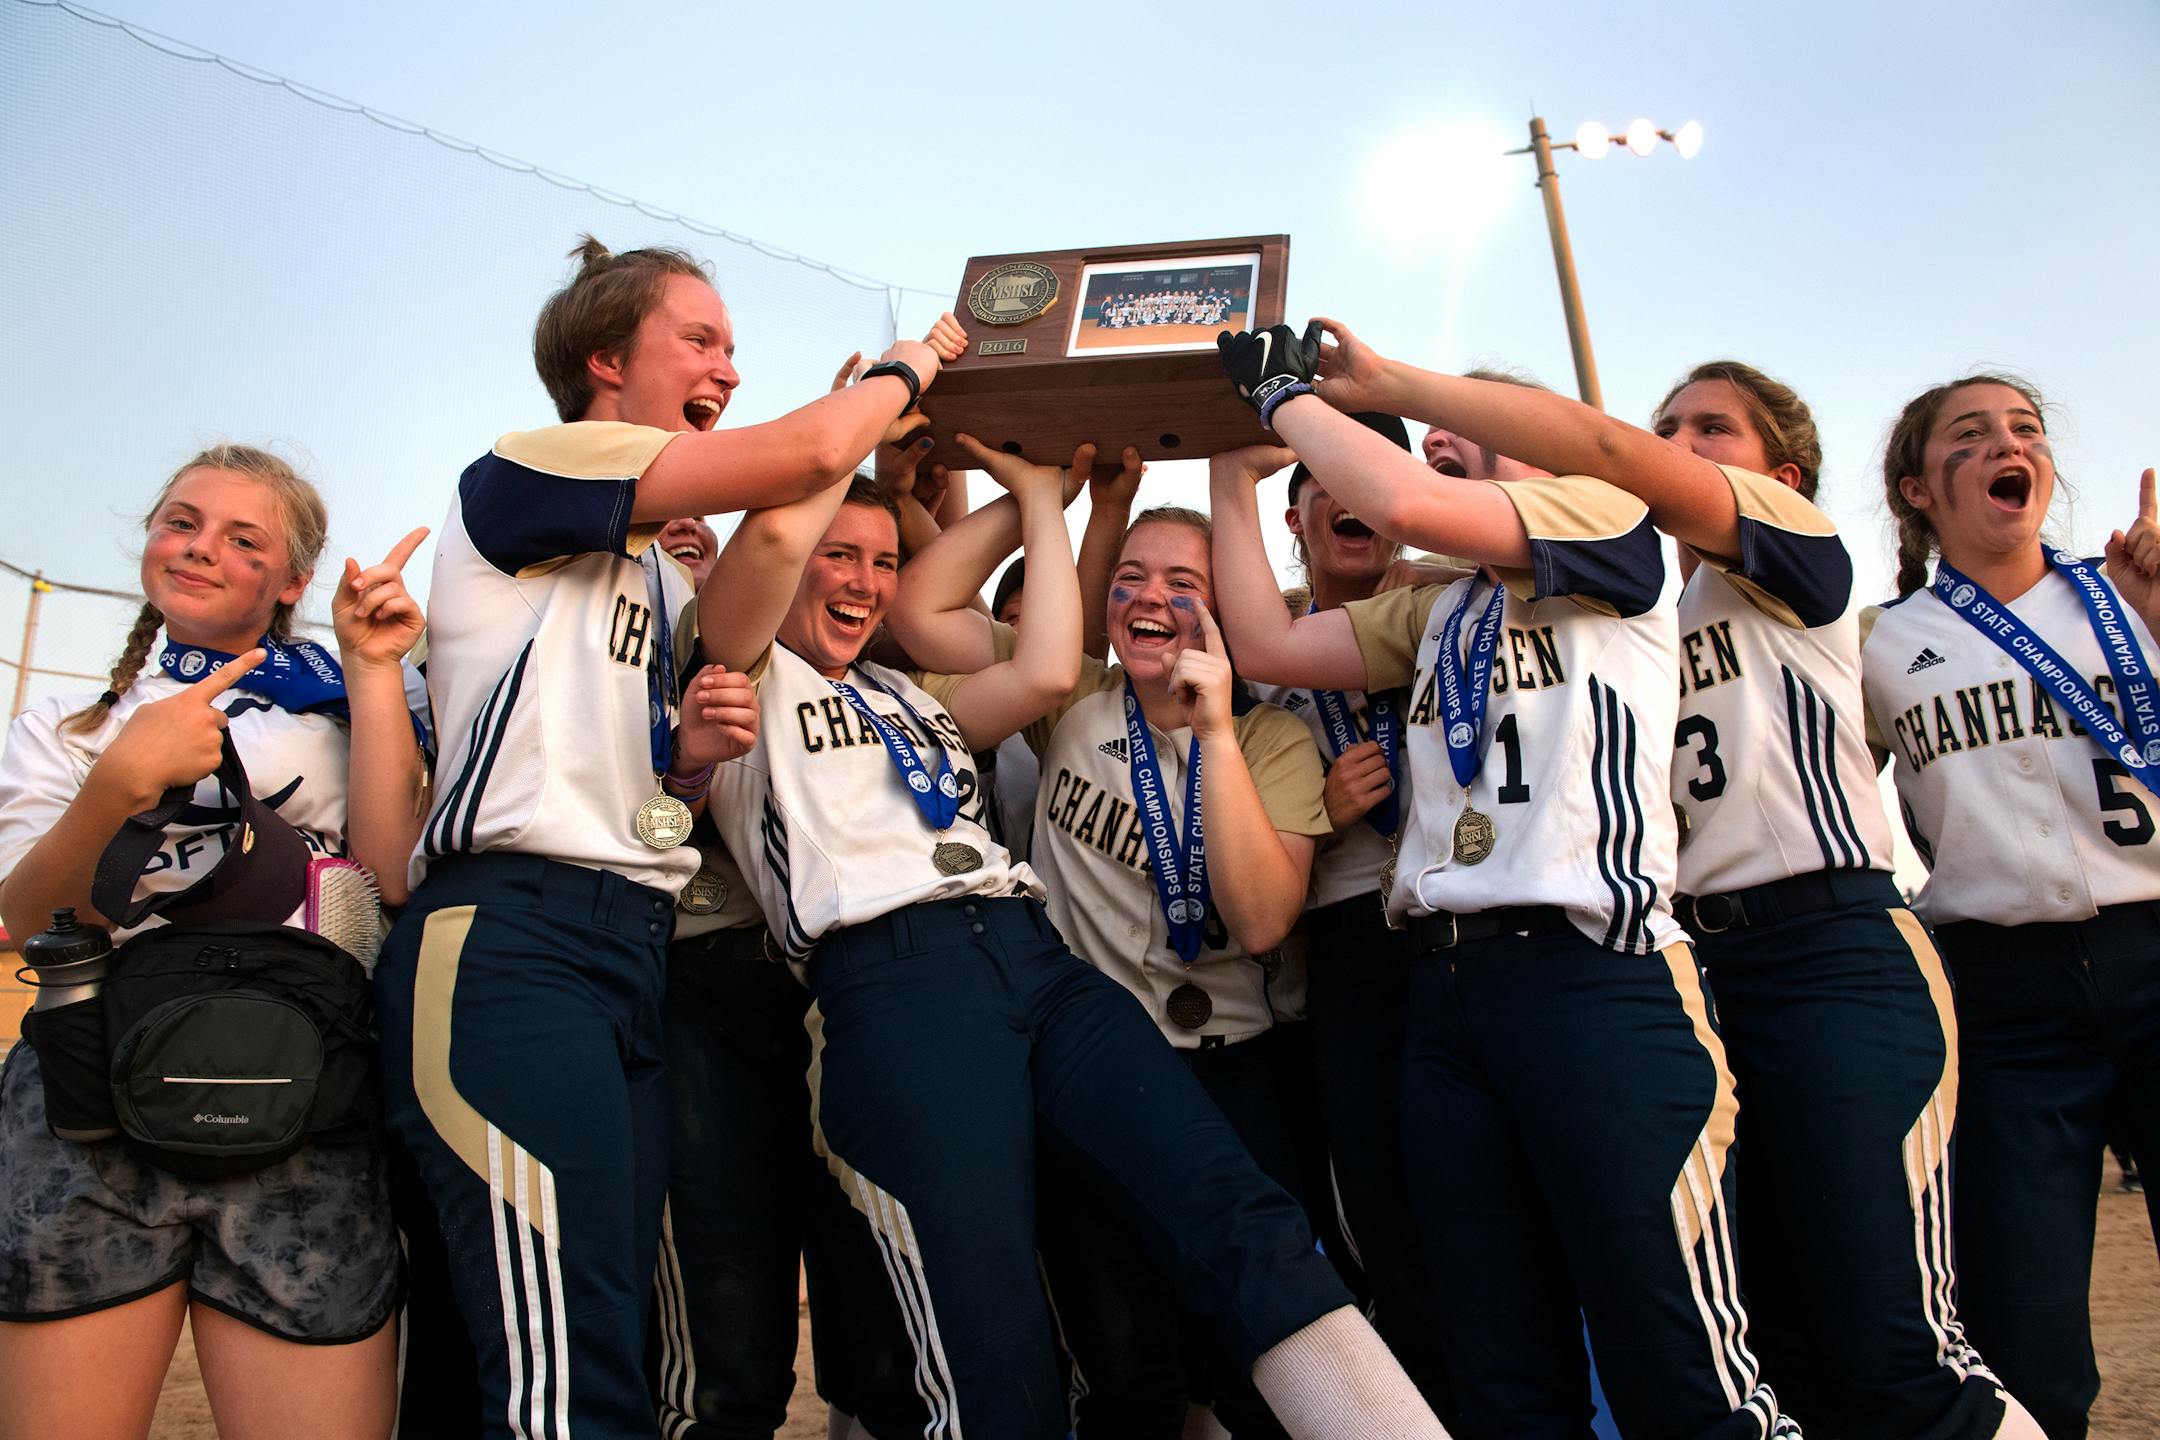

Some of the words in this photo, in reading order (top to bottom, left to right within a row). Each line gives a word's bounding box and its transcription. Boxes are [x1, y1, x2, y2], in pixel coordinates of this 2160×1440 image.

[989, 284, 1038, 300] MSHSL
[983, 341, 1022, 353] 2016
[1471, 659, 1486, 711] STATE
[1479, 583, 1505, 653] CHAMPIO
[2071, 566, 2140, 676] CHAMPIONSHIPS
[1907, 656, 1946, 675] adidas
[1971, 602, 2015, 637] STATE
[2012, 635, 2123, 743] CHAMPIONSHIPS
[833, 681, 916, 769] CHAMPIONSHIPS
[1321, 690, 1350, 753] AMPIONS
[2128, 682, 2159, 735] STATE
[1098, 744, 1129, 763] adidas
[1128, 720, 1149, 764] STATE
[1495, 713, 1530, 804] 1
[1675, 714, 1727, 802] 3
[650, 815, 680, 829] MSHSL
[2092, 758, 2156, 847] 5
[1138, 768, 1181, 896] CHAMPIONSHIPS
[1188, 845, 1204, 893] STATE
[204, 1114, 249, 1124] Columbia
